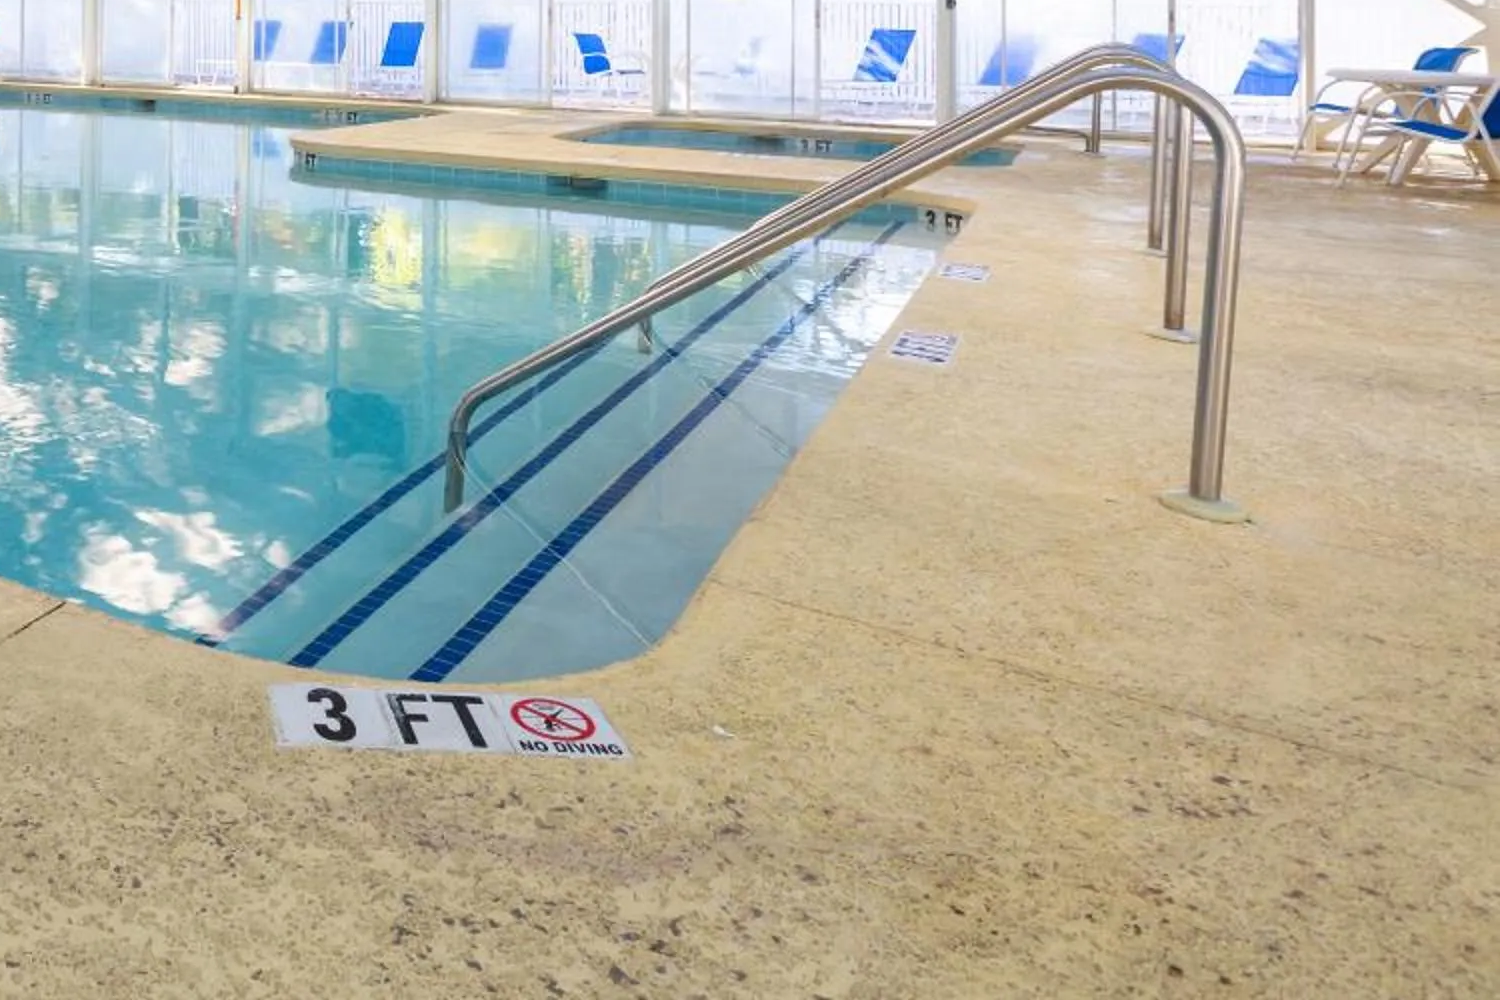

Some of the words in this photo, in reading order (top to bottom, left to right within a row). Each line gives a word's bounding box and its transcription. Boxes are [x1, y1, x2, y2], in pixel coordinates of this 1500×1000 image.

[945, 212, 963, 231] FT
[307, 687, 357, 742] 3
[386, 693, 488, 748] FT
[518, 740, 548, 752] NO
[553, 741, 623, 755] DIVING
